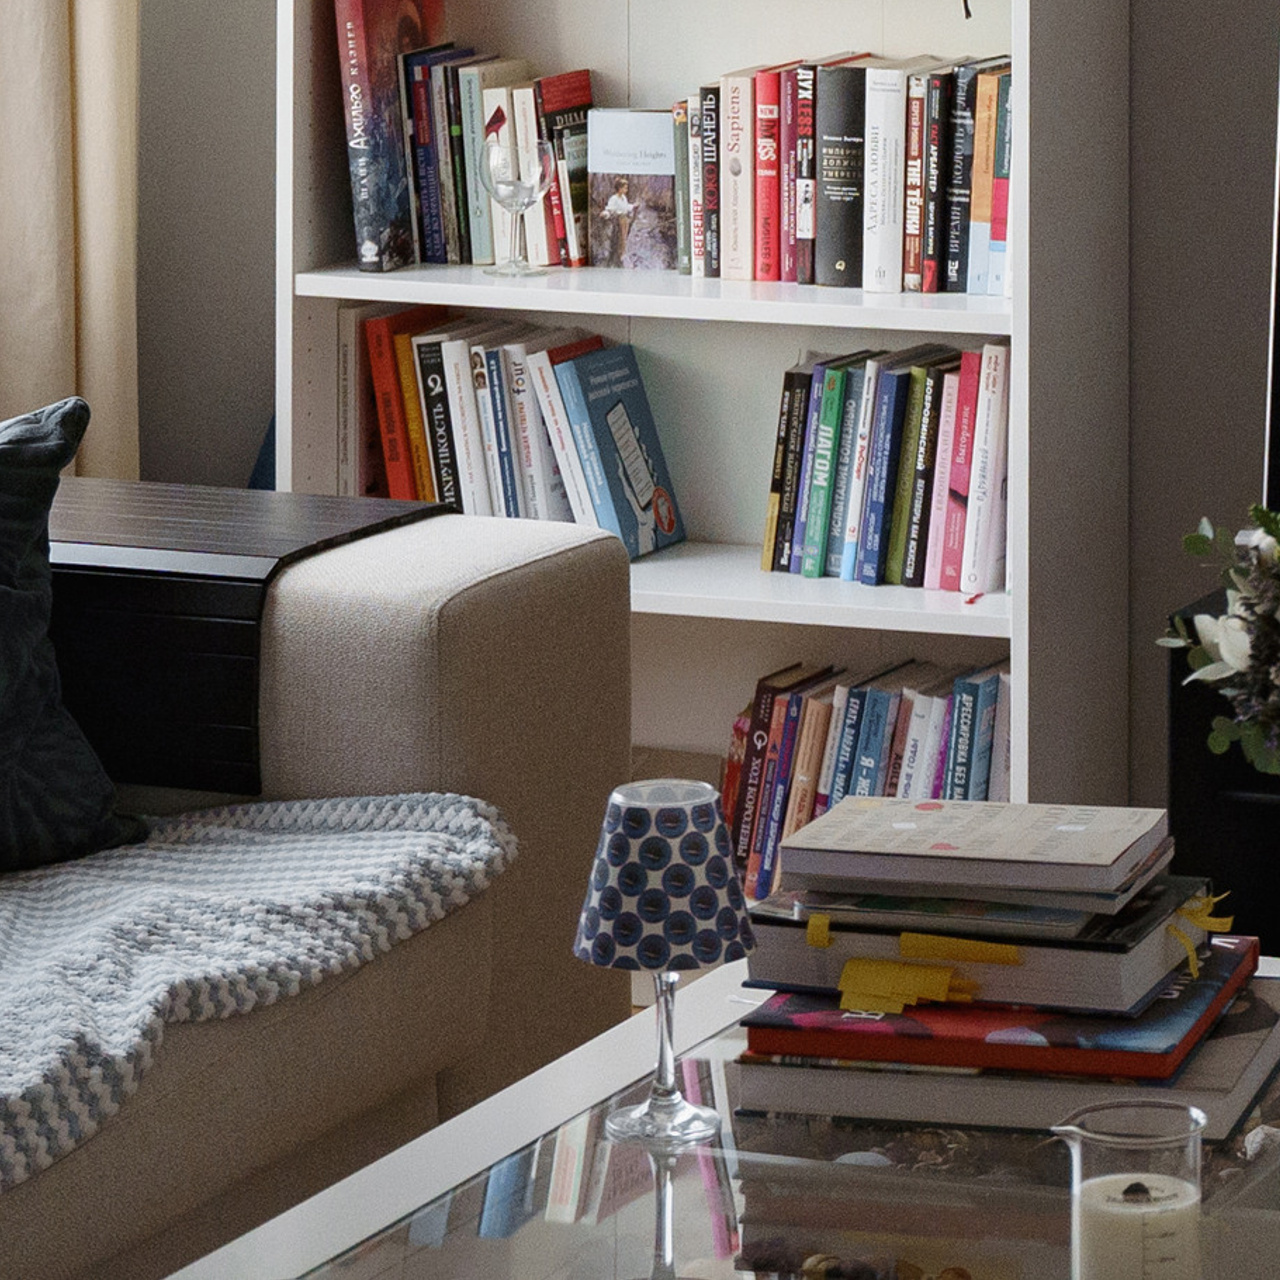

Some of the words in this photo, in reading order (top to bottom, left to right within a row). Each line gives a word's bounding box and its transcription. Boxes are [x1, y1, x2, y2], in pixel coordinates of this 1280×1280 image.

[727, 86, 742, 154] Sapiens
[797, 68, 814, 136] ДУХLESS
[911, 100, 919, 126] СЕРГЕЙ
[704, 94, 717, 163] ШАНЕЛЬ
[870, 125, 880, 176] ЛЮБВИ
[639, 150, 667, 160] Heights
[906, 158, 922, 186] THE
[928, 124, 940, 192] ГАСТАРБАЙТЕР
[952, 128, 964, 185] КОЛОТЬ
[704, 164, 717, 210] КОКО
[867, 178, 879, 234] АДРЕСА
[904, 188, 923, 234] ТЁЛКИ
[692, 199, 704, 258] БЕГБЕДЕР
[949, 207, 960, 252] ВРЕМЯ
[511, 360, 528, 396] four
[516, 401, 528, 433] ЧЕТВЕРКА
[838, 399, 857, 463] БОЛЕЗНЬЮ
[915, 377, 934, 470] ДОБРОВИНСКИЙ
[941, 383, 954, 428] ЭТИКЕТ
[430, 403, 458, 506] ИХРУПКОСТЬ
[520, 434, 533, 468] БОЛЬШАЯ
[581, 422, 594, 449] Новые
[588, 451, 603, 486] правила
[815, 424, 833, 486] ЛАГОМ
[955, 405, 971, 464] Выгорание
[573, 422, 591, 459] деловой
[583, 460, 602, 505] переписки
[935, 430, 951, 512] ЕВРОПЕЙСКИЙ
[830, 464, 849, 537] ИСПЫТАНИЕ
[911, 478, 926, 523] ПЕРЕГОВОРЫ
[910, 524, 921, 539] КАК
[905, 540, 920, 579] ИСКУССТВО
[956, 693, 974, 763] ДРЕССИРОВКА
[747, 756, 764, 785] ХОД
[860, 756, 874, 767] Я
[888, 752, 903, 790] AGILE
[906, 738, 918, 770] ГОДЫ
[954, 765, 968, 785] БЕЗ
[736, 787, 760, 857] КОРОЛЕВЫ
